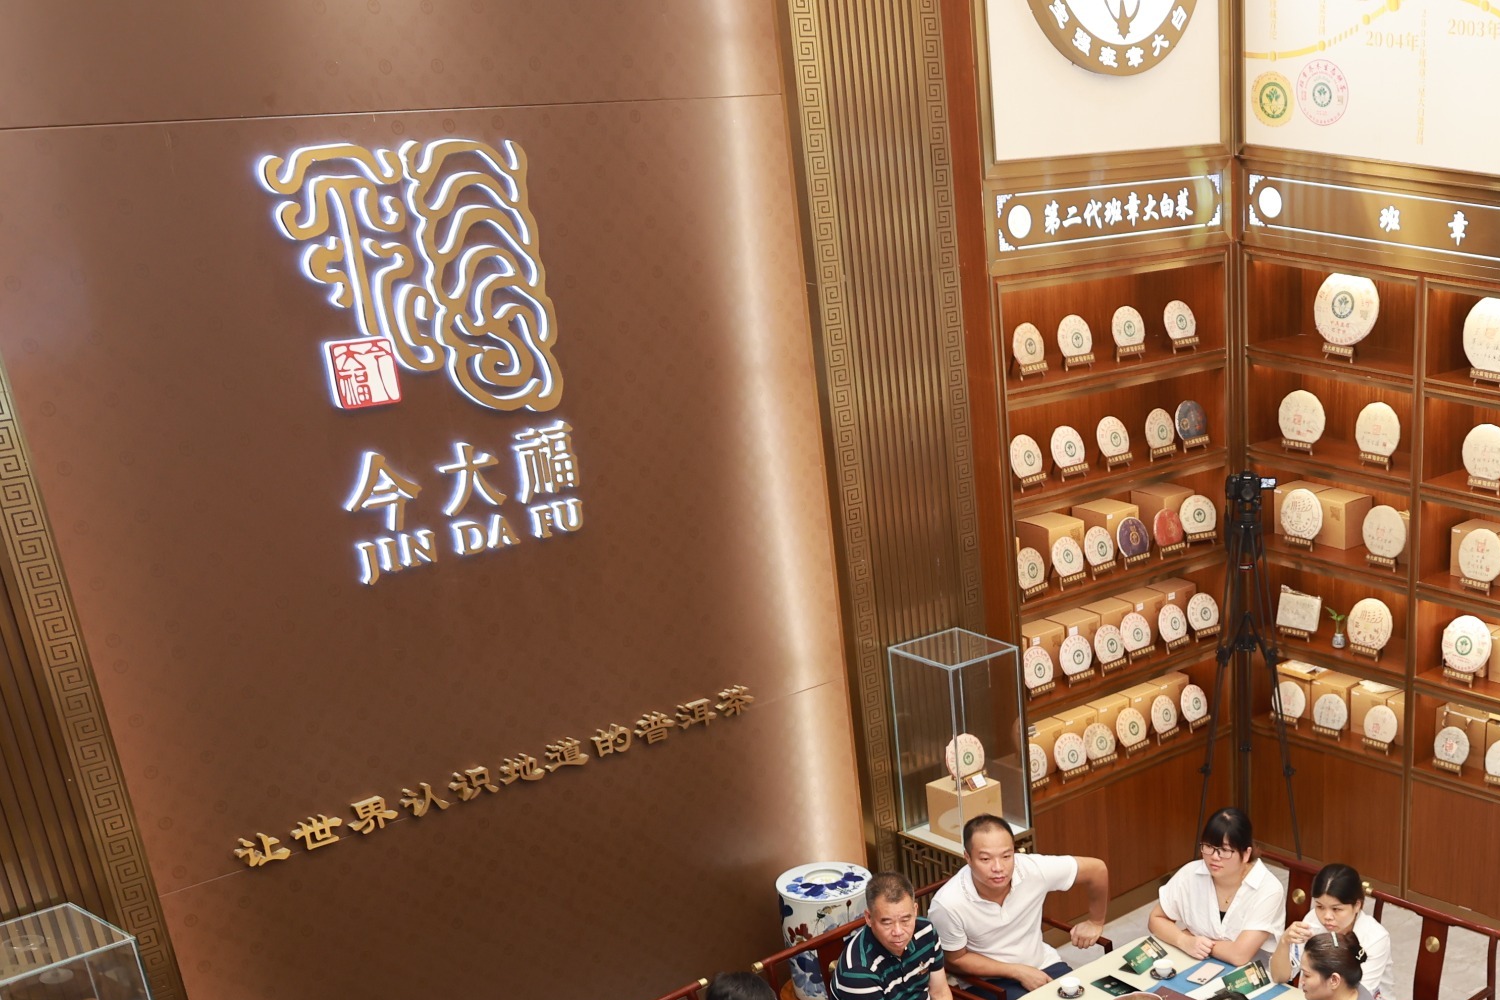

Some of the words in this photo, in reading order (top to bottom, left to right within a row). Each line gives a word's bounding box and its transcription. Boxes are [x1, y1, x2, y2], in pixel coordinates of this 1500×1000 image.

[1044, 188, 1194, 235] 第二代班章大白菜
[345, 420, 580, 532] 今大福
[357, 529, 438, 585] JIN
[452, 513, 521, 555] DA
[530, 498, 584, 538] FU
[233, 684, 756, 868] 让世界认识地道的普洱茶
